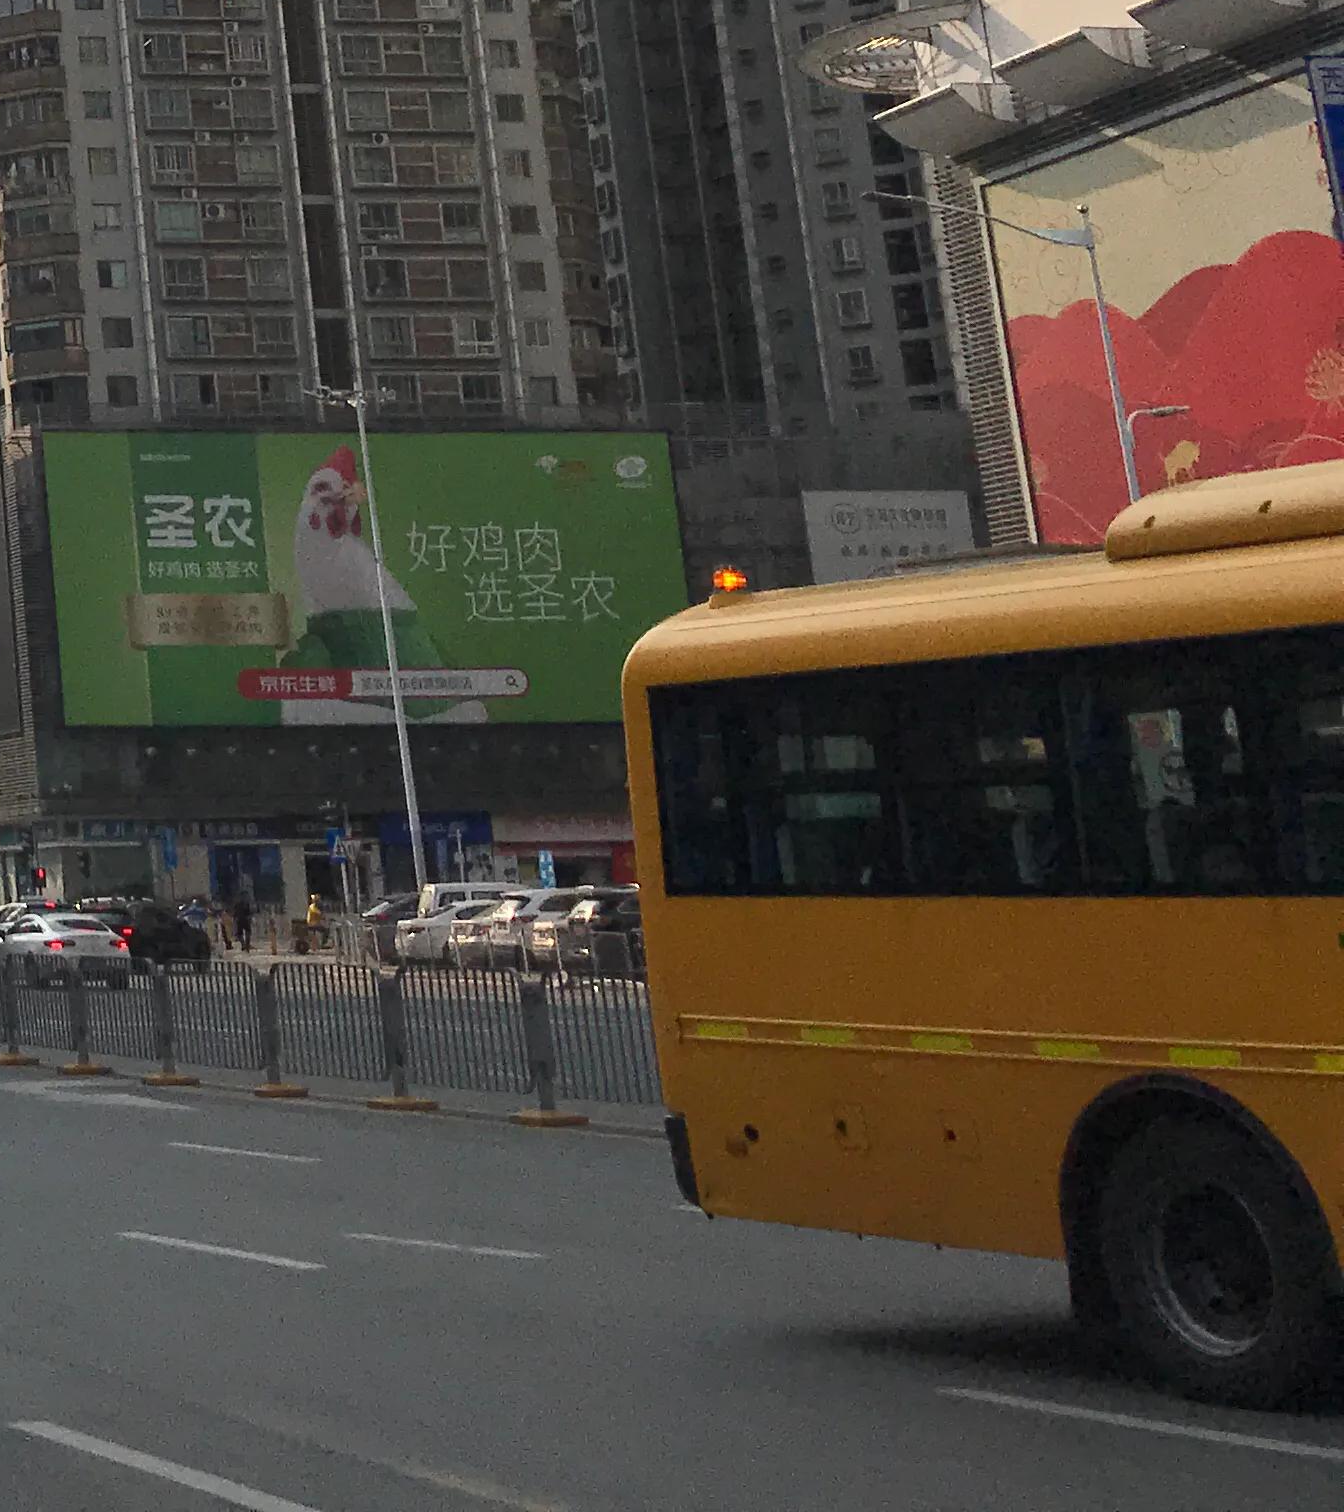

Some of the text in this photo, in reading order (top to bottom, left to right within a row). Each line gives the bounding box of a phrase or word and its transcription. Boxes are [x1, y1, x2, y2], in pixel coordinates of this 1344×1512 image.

[144, 494, 256, 548] 圣农
[406, 521, 562, 571] 好鸡肉
[464, 571, 620, 621] 选圣农
[259, 675, 337, 693] 京东生鲜
